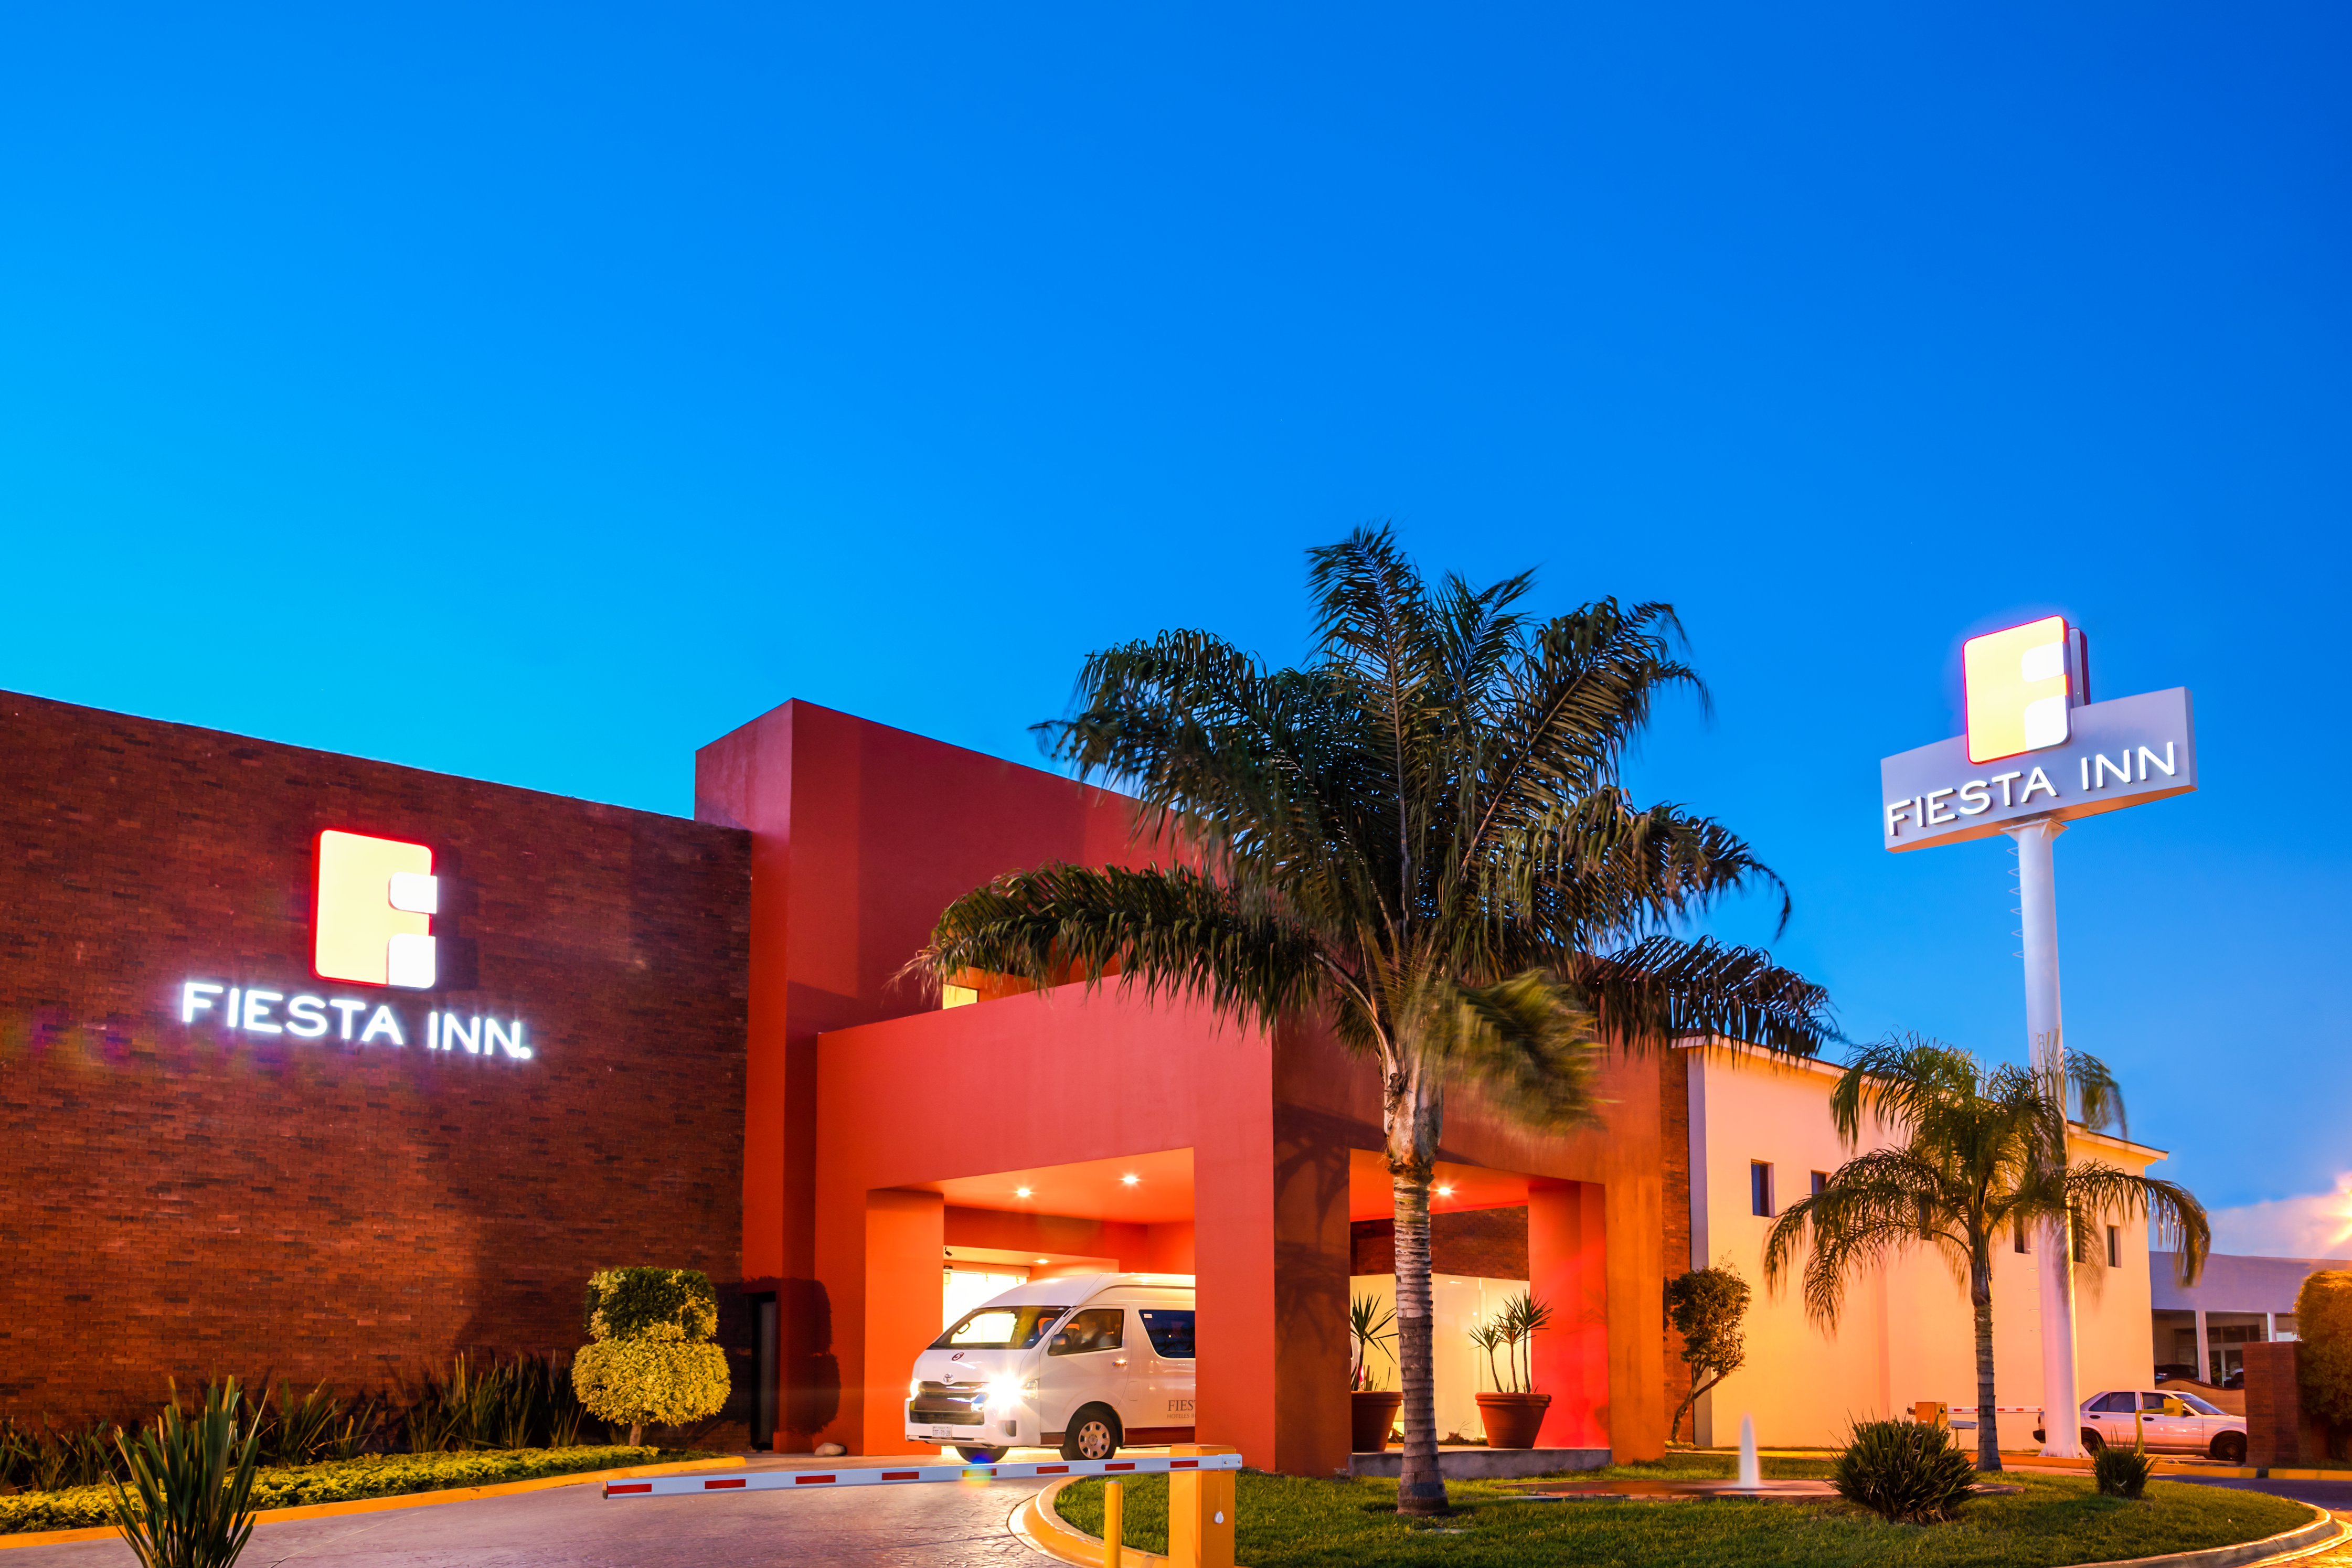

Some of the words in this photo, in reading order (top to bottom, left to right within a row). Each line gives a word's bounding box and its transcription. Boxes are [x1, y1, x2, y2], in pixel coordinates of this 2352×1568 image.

[1887, 767, 2059, 836] FIESTA
[2081, 741, 2176, 791] INN
[183, 982, 403, 1045] FIESTA
[1168, 1400, 1196, 1411] FIES
